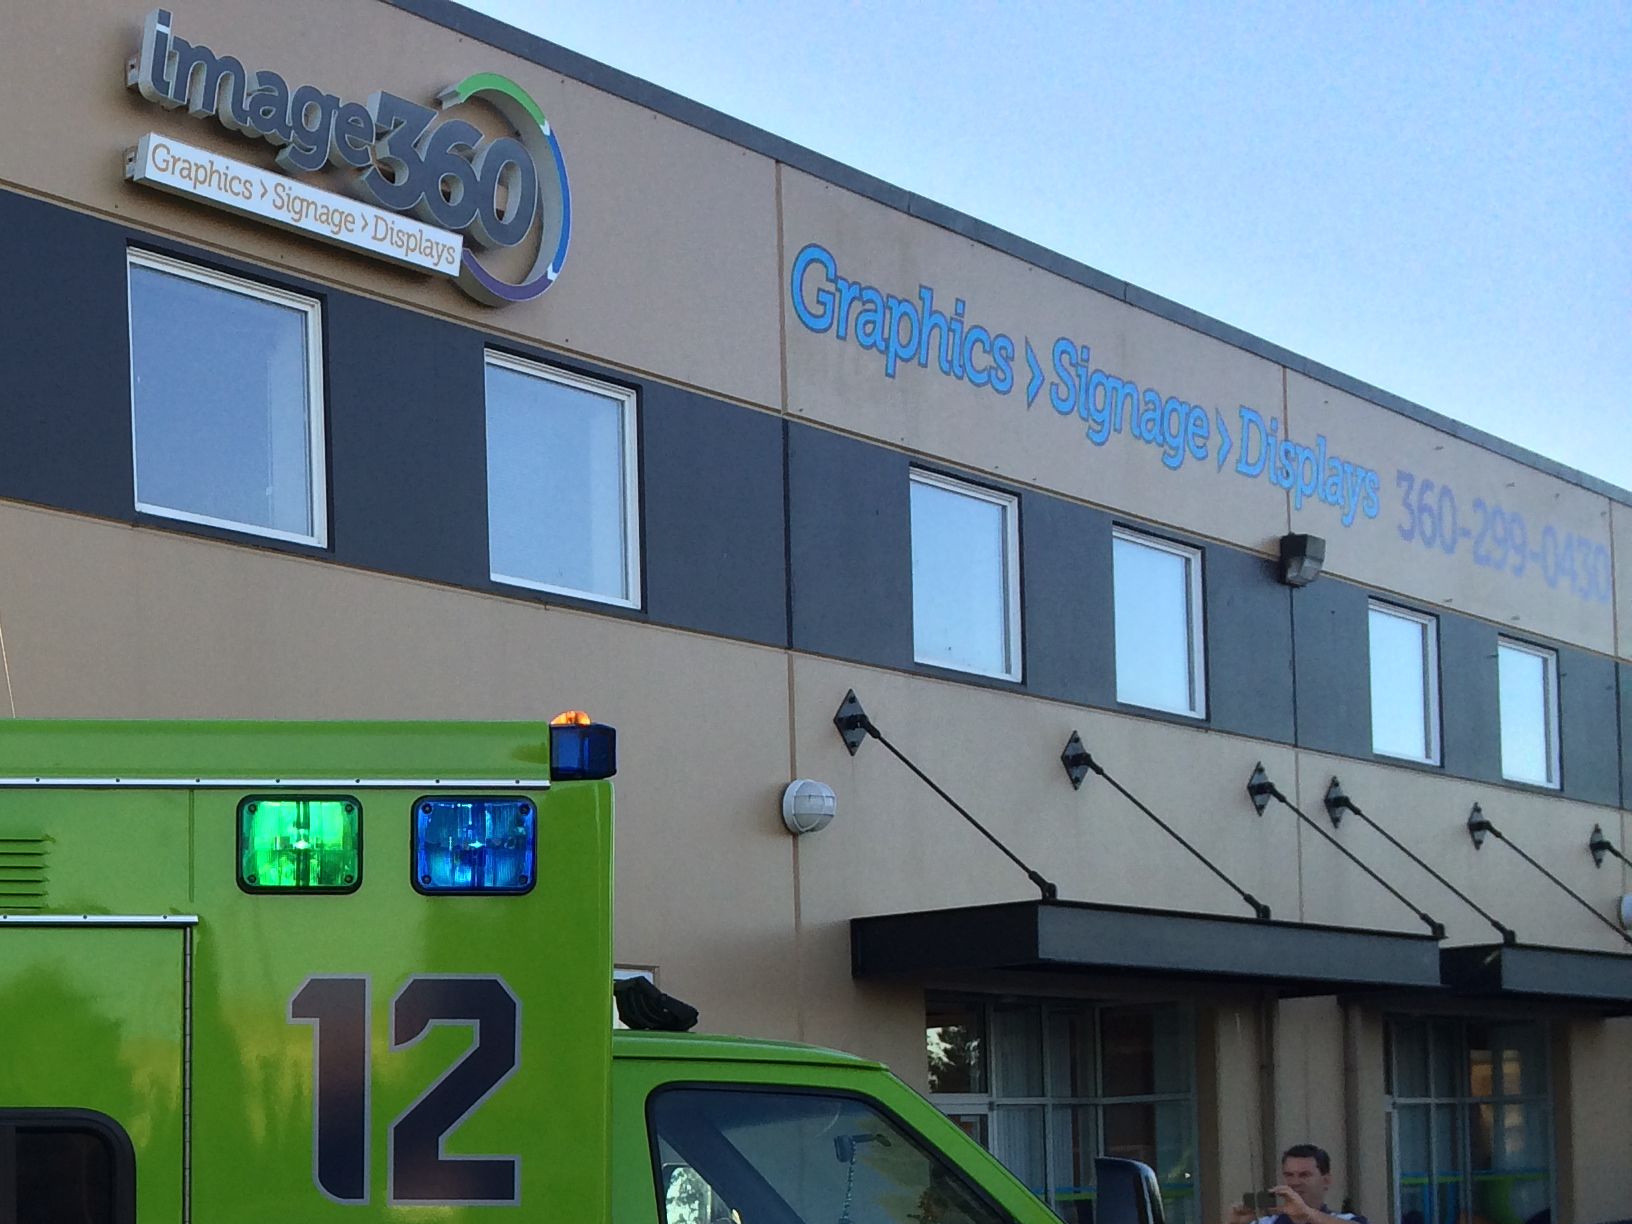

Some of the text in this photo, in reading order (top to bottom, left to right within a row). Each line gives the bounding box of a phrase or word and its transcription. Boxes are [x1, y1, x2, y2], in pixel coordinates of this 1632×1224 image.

[144, 8, 539, 248] image360
[151, 143, 457, 267] Graphics Signage Displays
[790, 243, 1381, 528] Graphics Signage Displays
[1396, 468, 1612, 604] 360-299-0430
[286, 972, 522, 1207] 12
